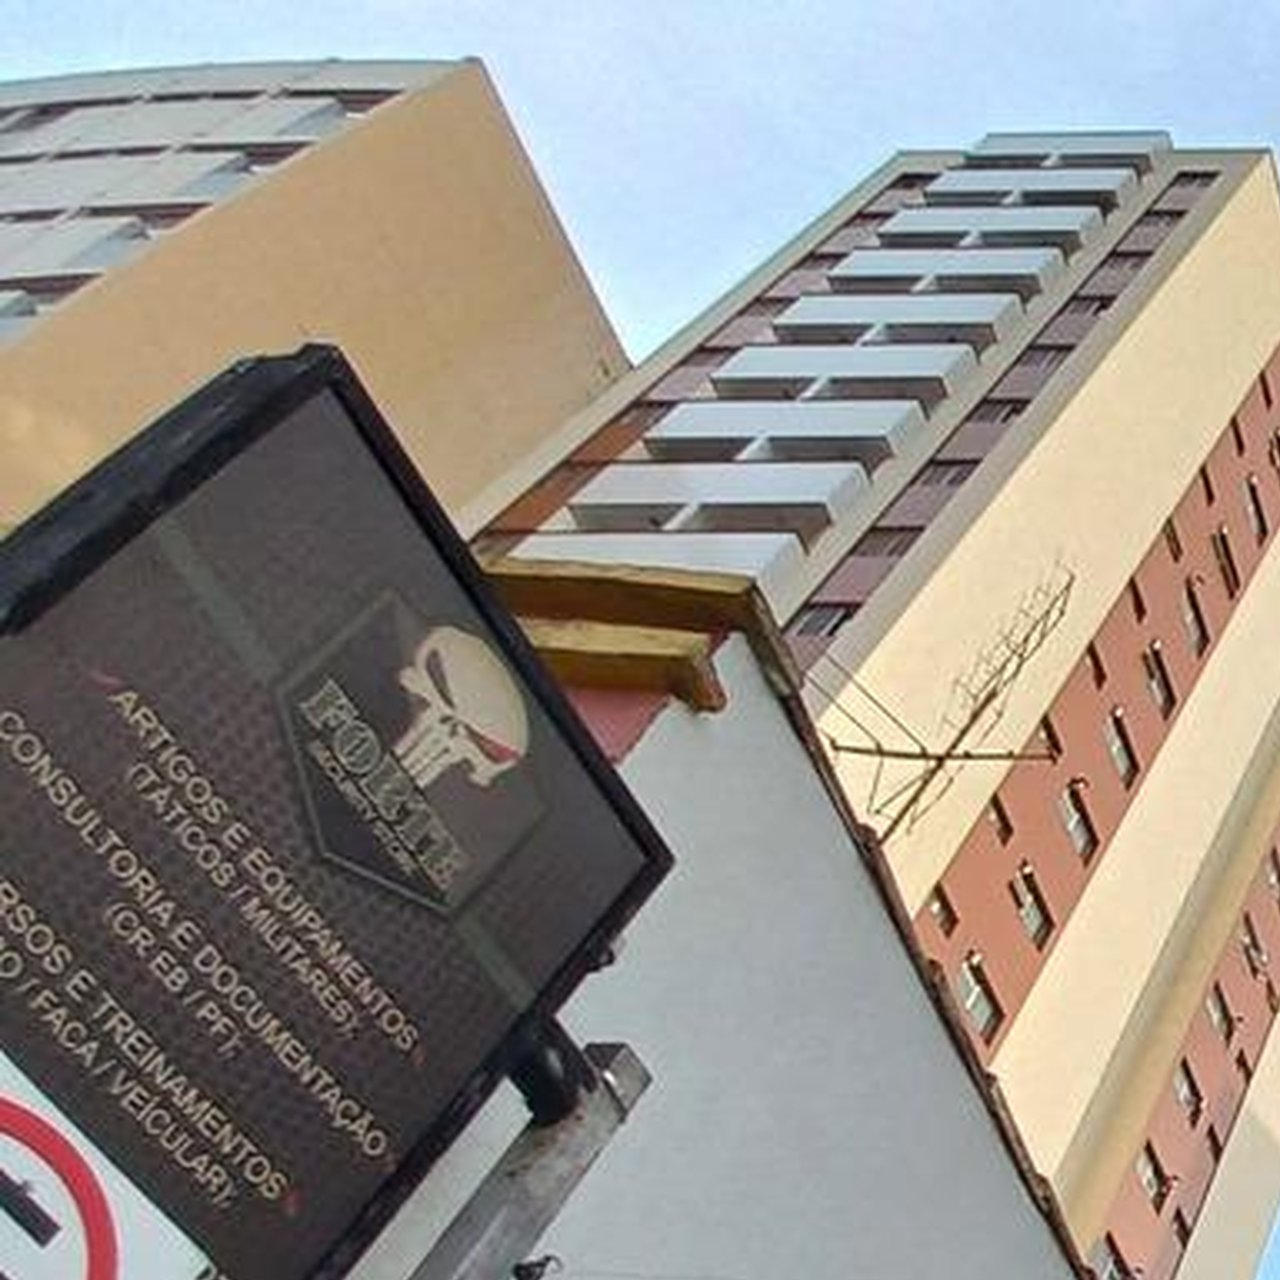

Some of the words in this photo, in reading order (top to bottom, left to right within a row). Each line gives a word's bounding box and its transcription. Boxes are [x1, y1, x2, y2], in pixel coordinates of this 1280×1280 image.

[107, 690, 229, 825] ARTIGOS
[222, 822, 251, 850] E
[242, 847, 419, 1051] EQUIPAMENTOS
[300, 678, 467, 892] FORTE
[0, 711, 176, 928] CONSULTORIA
[169, 920, 201, 951] E
[193, 944, 388, 1156] DOCUMENTAÇÃO
[30, 990, 99, 1067] FACA
[65, 969, 98, 1002] E
[89, 990, 288, 1199] TREINAMENTOS
